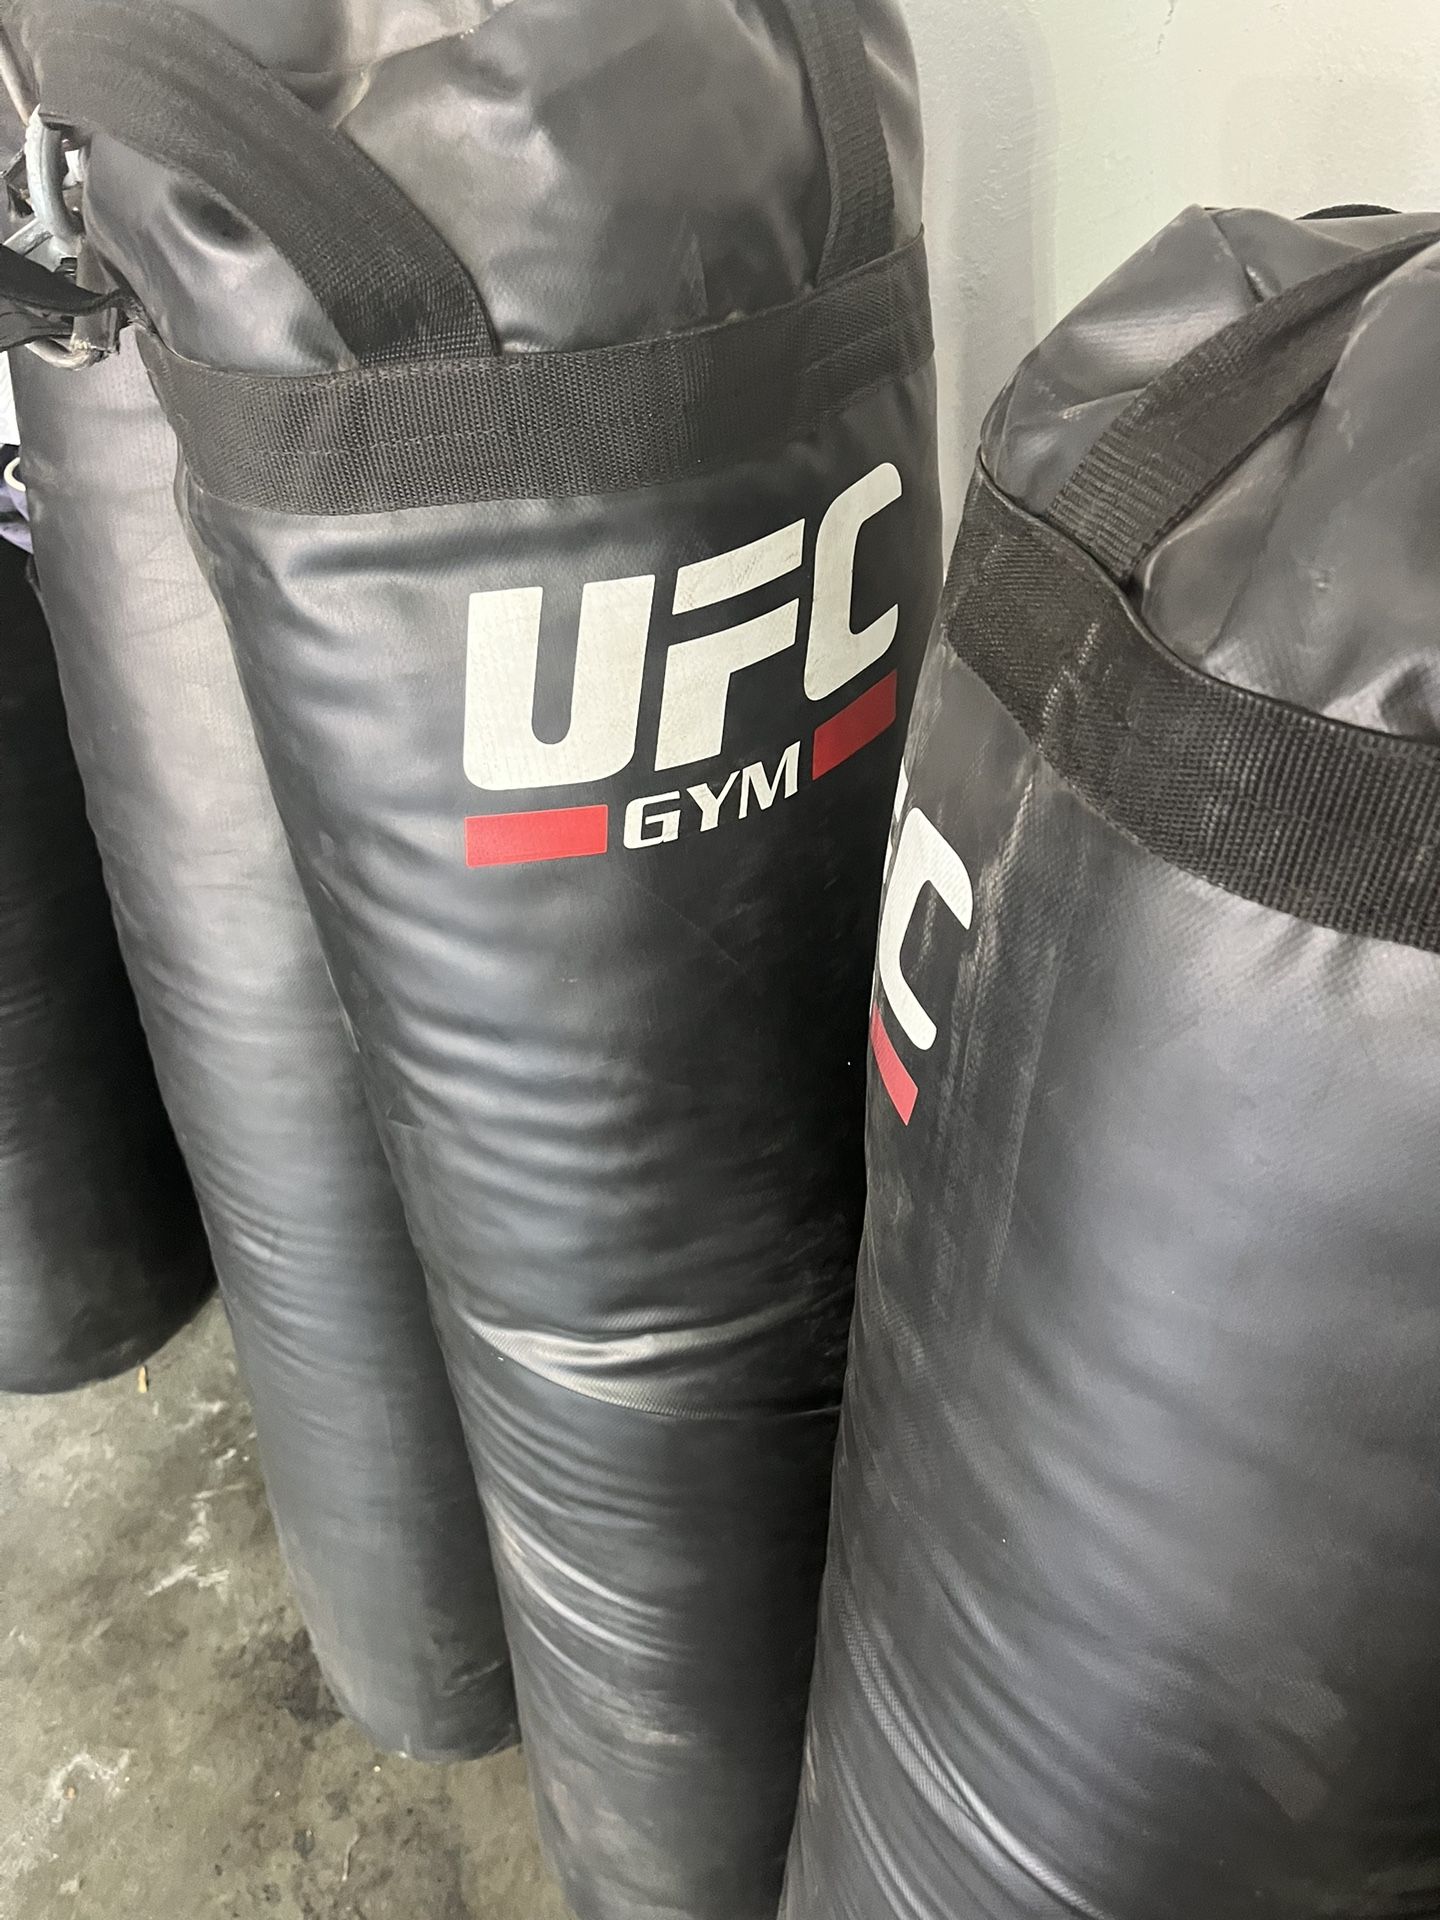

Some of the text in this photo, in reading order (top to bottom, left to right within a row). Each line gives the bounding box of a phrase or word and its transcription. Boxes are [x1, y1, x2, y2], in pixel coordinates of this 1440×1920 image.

[463, 462, 902, 791] UFC
[623, 741, 801, 850] GYM
[876, 758, 974, 1051] C
